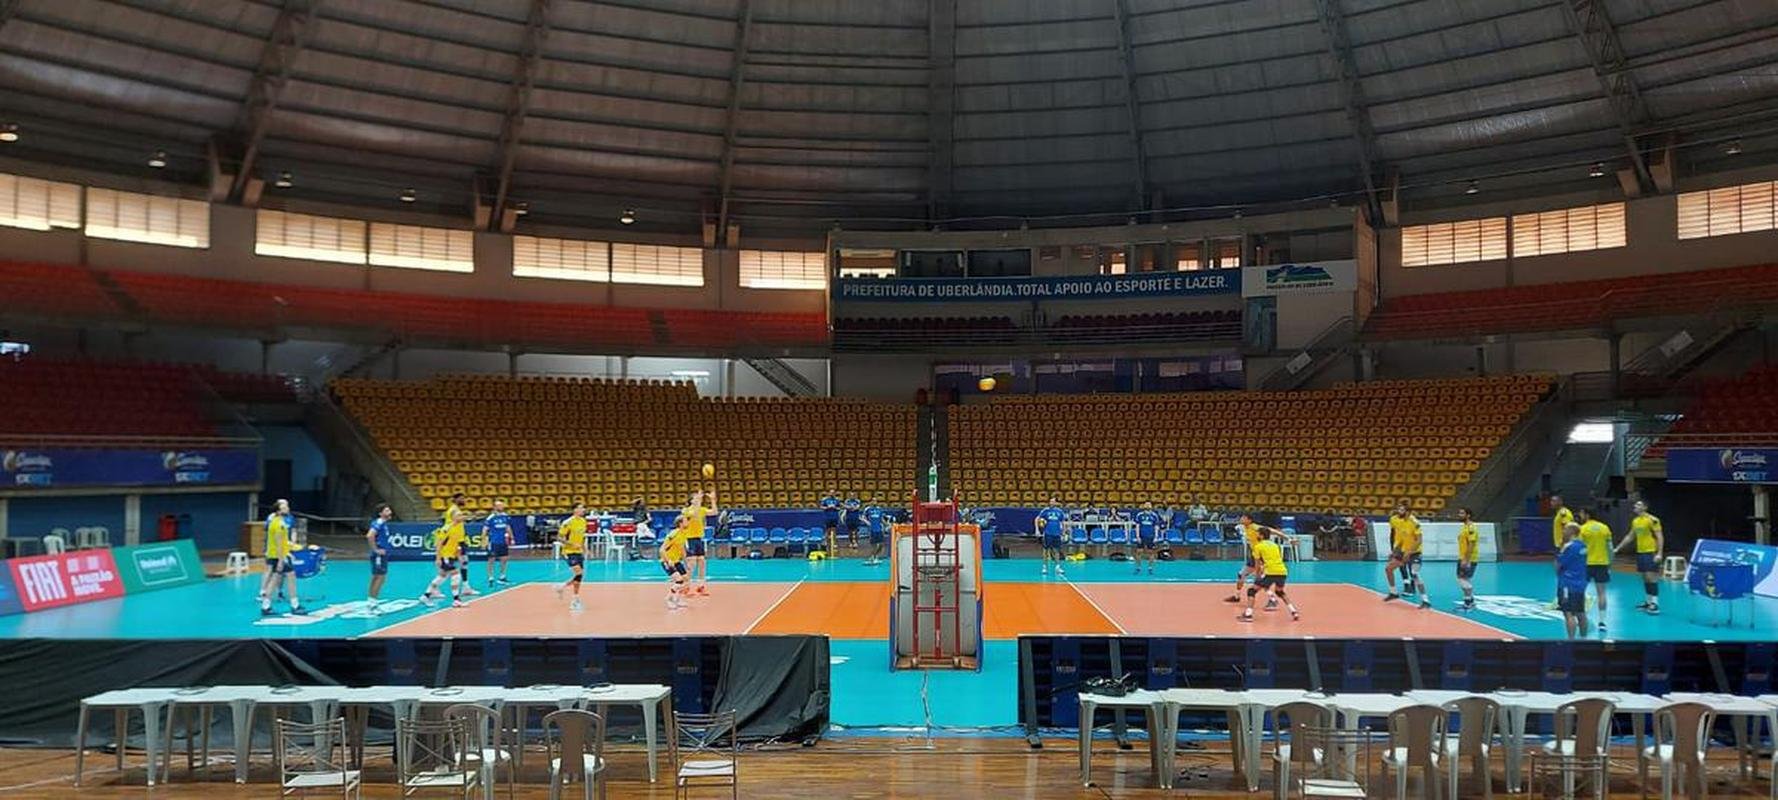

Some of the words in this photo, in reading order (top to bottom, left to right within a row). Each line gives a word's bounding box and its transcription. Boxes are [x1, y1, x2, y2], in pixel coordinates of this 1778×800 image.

[843, 283, 916, 297] PREFEITURA
[919, 284, 935, 297] DE
[1054, 282, 1093, 295] APOIO
[1094, 281, 1112, 293] AO
[1115, 278, 1171, 293] ESPORTE
[1174, 278, 1182, 290] E
[1185, 276, 1229, 290] LAZER.
[19, 561, 67, 604] FIAT
